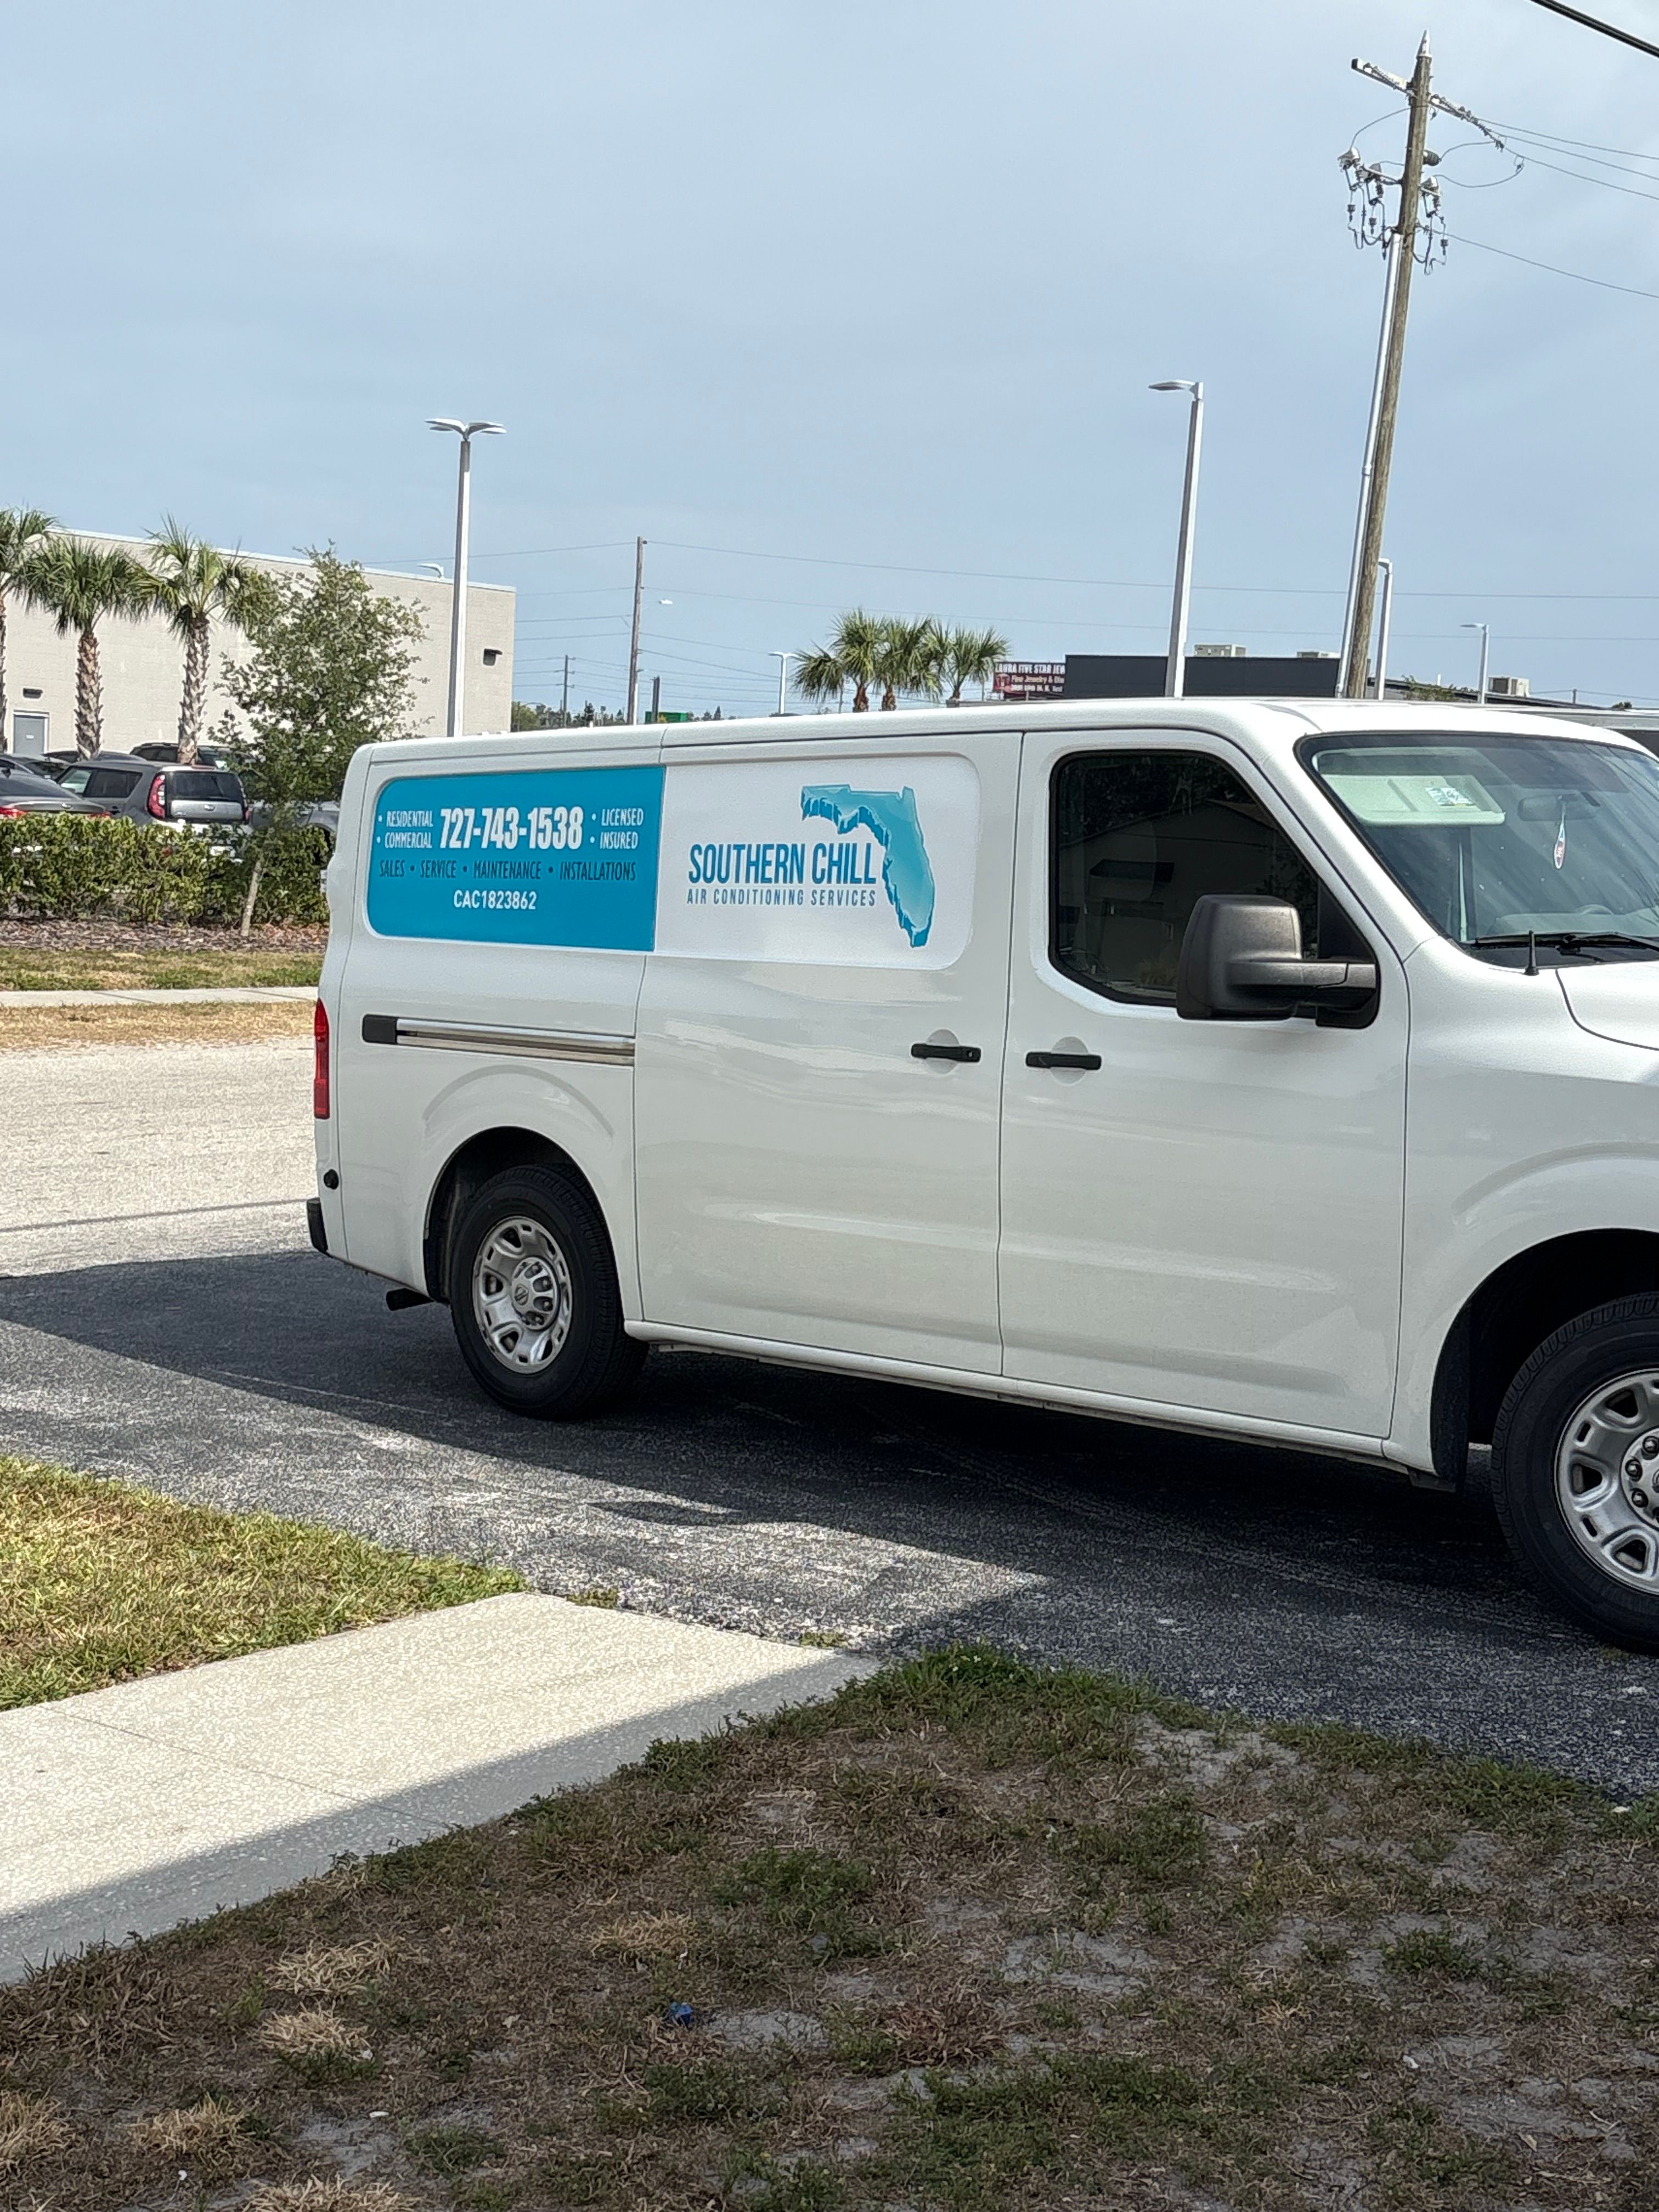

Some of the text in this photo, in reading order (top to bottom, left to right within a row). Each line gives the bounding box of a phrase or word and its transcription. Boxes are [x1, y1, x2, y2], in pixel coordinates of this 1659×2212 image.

[1018, 664, 1032, 674] FIVE
[1034, 664, 1052, 674] STAR
[386, 810, 433, 827] RESIDENTIAL
[601, 808, 644, 826] LICENSED
[439, 806, 584, 850] 727-743-1538
[385, 832, 433, 849] COMMERCIAL
[599, 831, 639, 850] INSURED
[379, 860, 636, 881] SALES SERVICE MAINTENANCE INSTALLATIONS
[688, 843, 877, 884] SOUTHERN CHILL
[453, 889, 538, 910] CAC1823862
[686, 888, 876, 907] AIR CONDITIONING SERVICES
